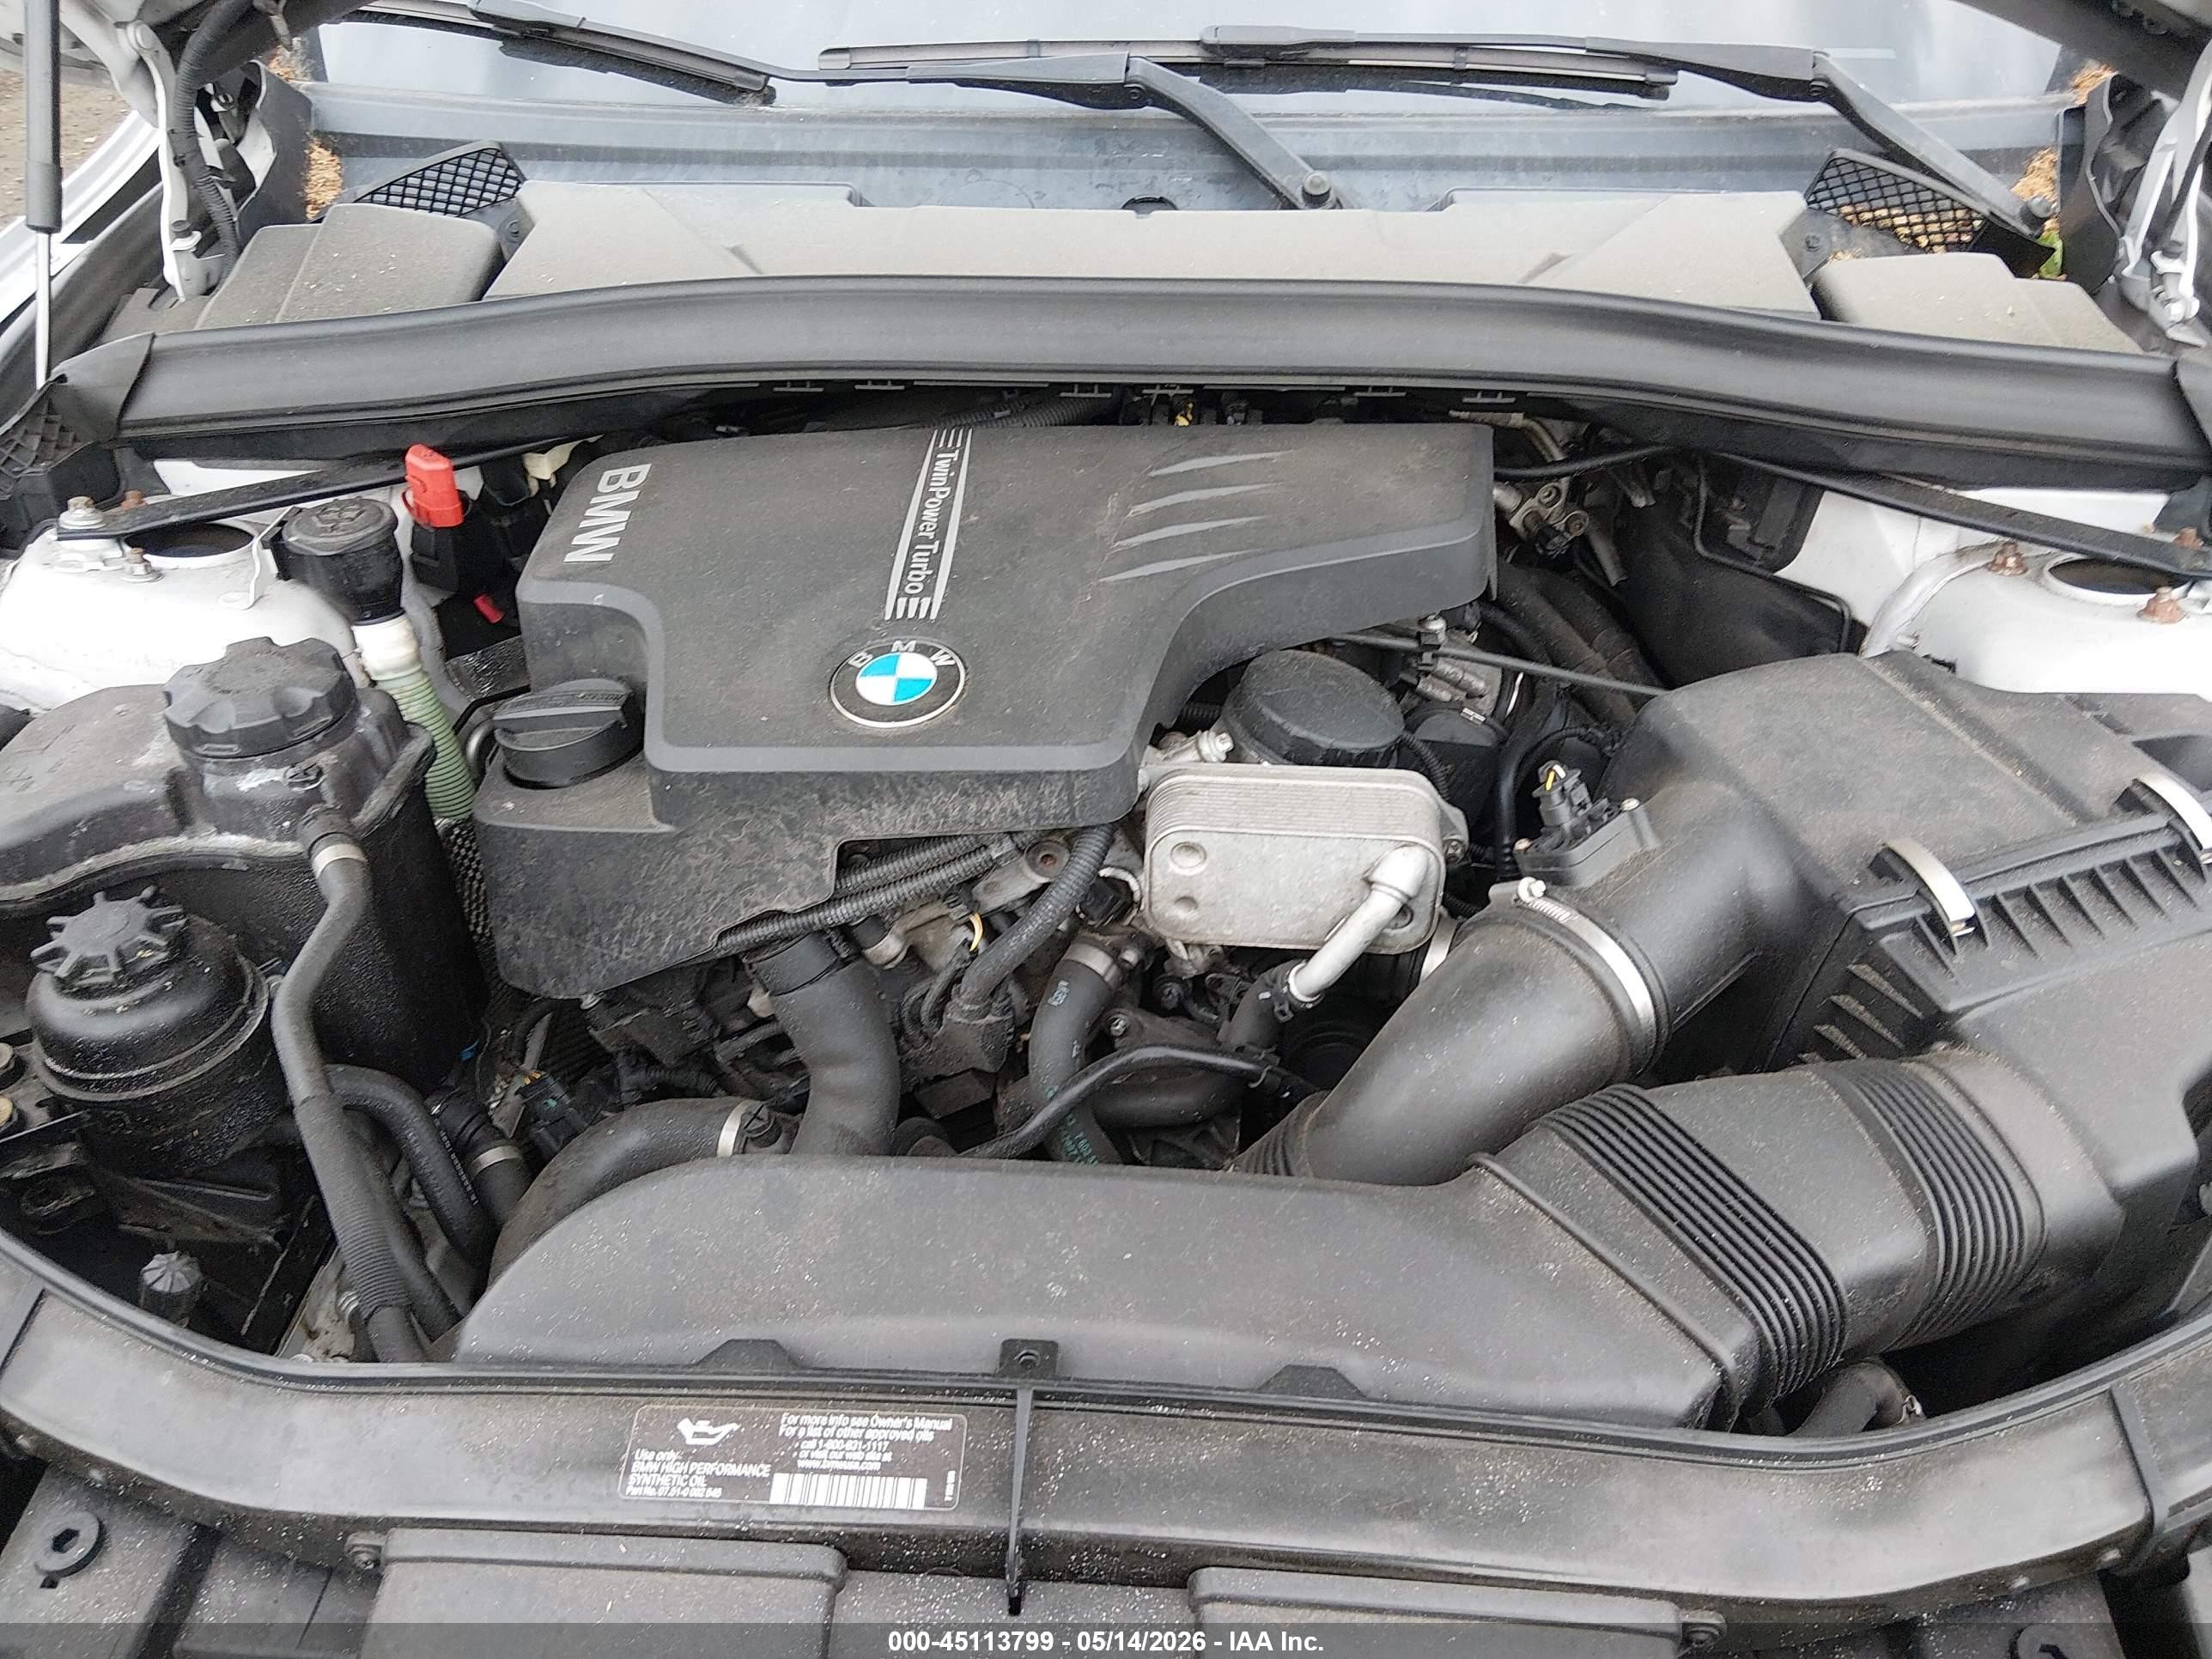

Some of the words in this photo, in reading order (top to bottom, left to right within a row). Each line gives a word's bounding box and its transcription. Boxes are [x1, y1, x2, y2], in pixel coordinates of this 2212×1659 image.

[915, 448, 959, 539] TwinPower
[562, 463, 653, 562] BMW
[905, 539, 939, 595] Turbo
[847, 639, 957, 672] BMW
[781, 1413, 799, 1425] For
[799, 1415, 827, 1425] more
[829, 1414, 849, 1426] info
[850, 1417, 869, 1427] see
[870, 1415, 912, 1429] Owner's
[914, 1417, 953, 1431] Manual
[779, 1424, 798, 1437] For
[823, 1425, 836, 1437] of
[836, 1426, 865, 1438] other
[865, 1429, 915, 1442] approved
[635, 1449, 655, 1461] Use
[631, 1462, 661, 1474] BMW
[660, 1462, 689, 1474] HIGH
[689, 1462, 771, 1478] PERFORMANCE
[628, 1474, 689, 1486] SYNTHETIC
[689, 1475, 707, 1487] OIL
